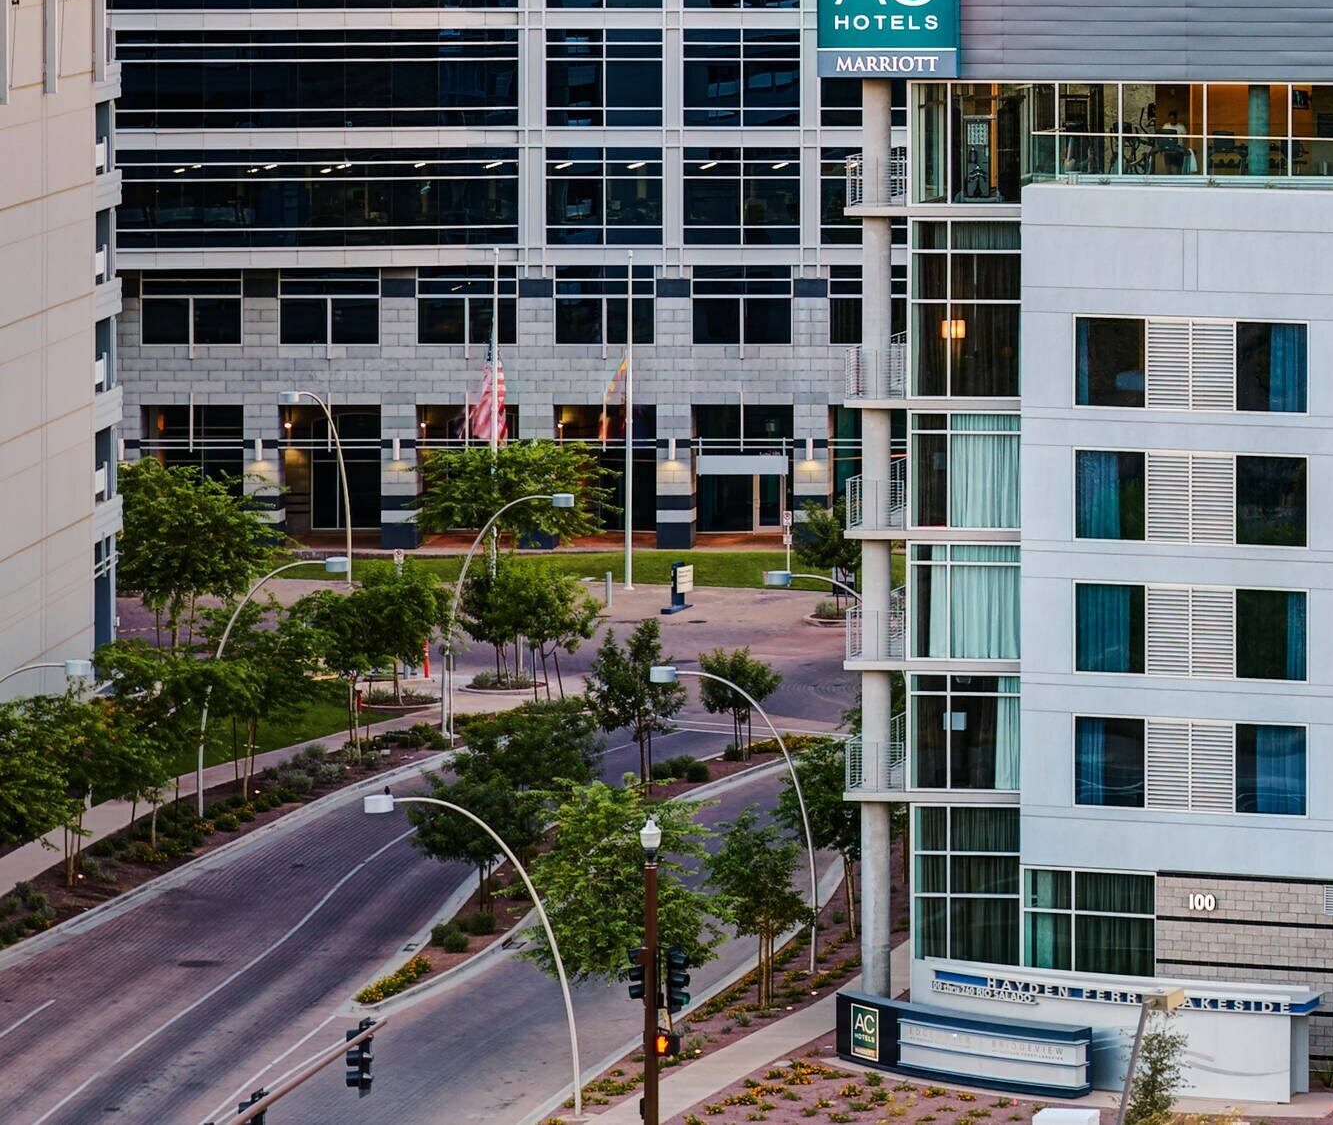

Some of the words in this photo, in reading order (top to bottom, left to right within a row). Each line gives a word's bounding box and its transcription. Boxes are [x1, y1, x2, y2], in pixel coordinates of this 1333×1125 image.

[834, 15, 939, 30] HOTELS
[836, 56, 939, 72] MARRIOTT
[1189, 893, 1216, 911] 100
[976, 987, 992, 997] RIO
[993, 990, 1032, 1003] SALADO
[987, 977, 1068, 998] HAYDEN
[1083, 988, 1137, 1003] FERR
[1181, 996, 1291, 1013] AKESIDE
[854, 1013, 875, 1034] AC
